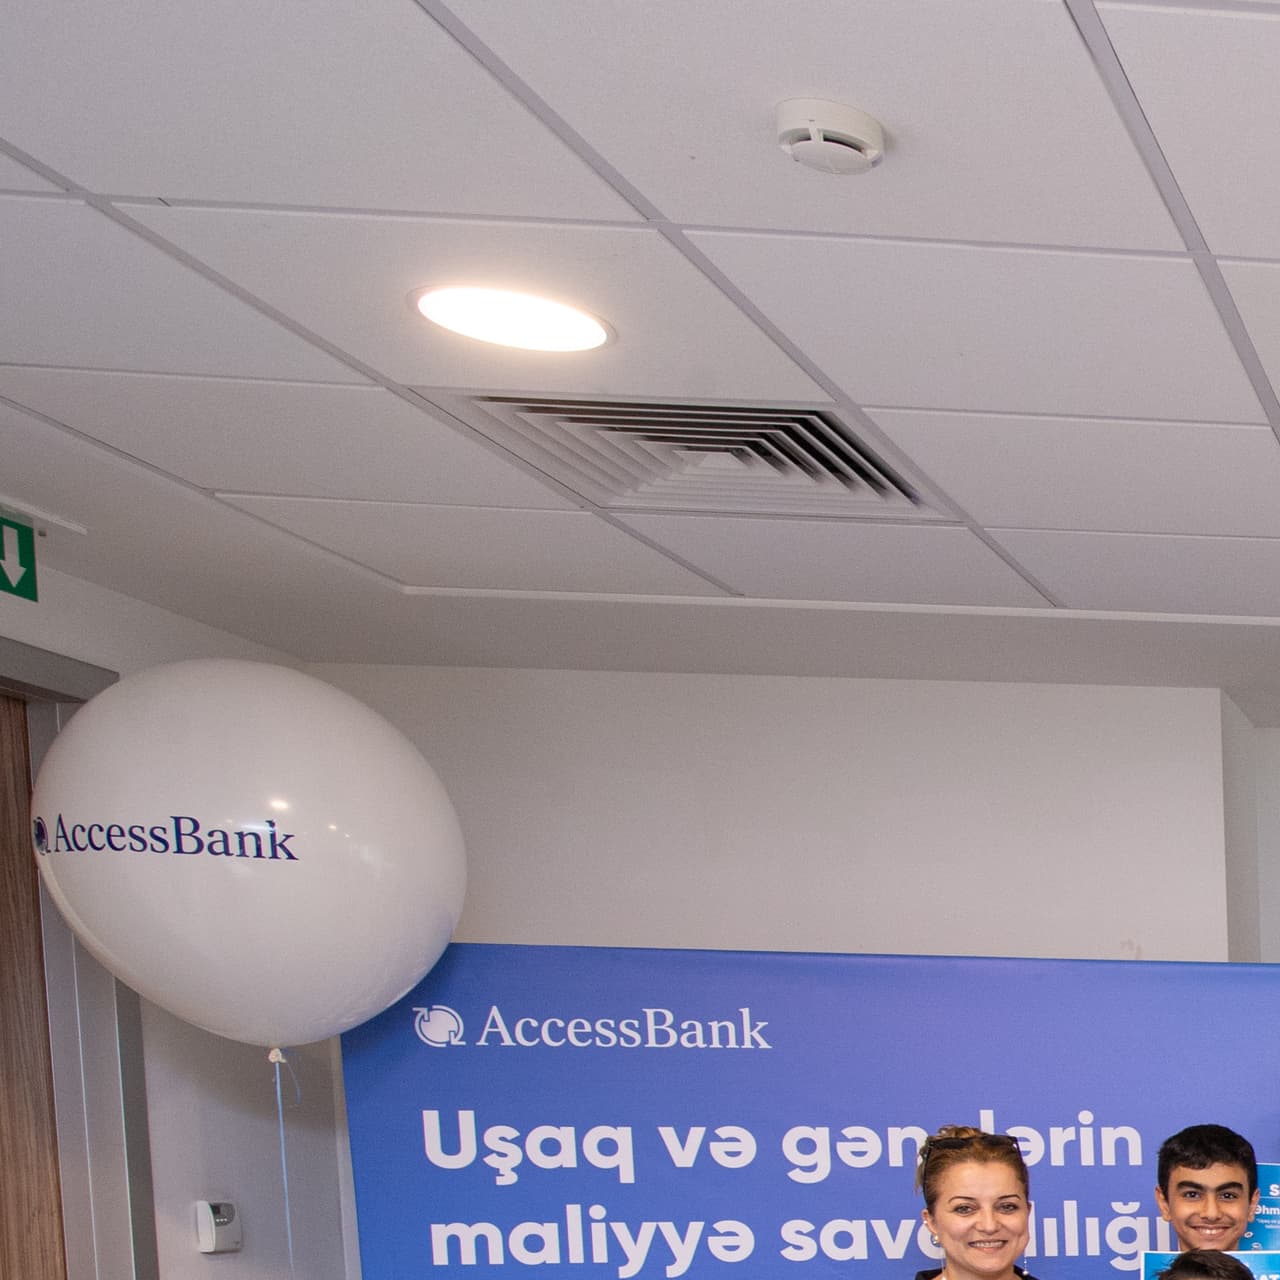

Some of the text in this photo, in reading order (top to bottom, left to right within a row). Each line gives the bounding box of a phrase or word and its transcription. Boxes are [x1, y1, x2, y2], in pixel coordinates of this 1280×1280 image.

[54, 813, 299, 860] AccessBank
[475, 1005, 773, 1049] AccessBank
[422, 1110, 1143, 1186] Uşaq və gənərin
[430, 1203, 755, 1279] maliyyə
